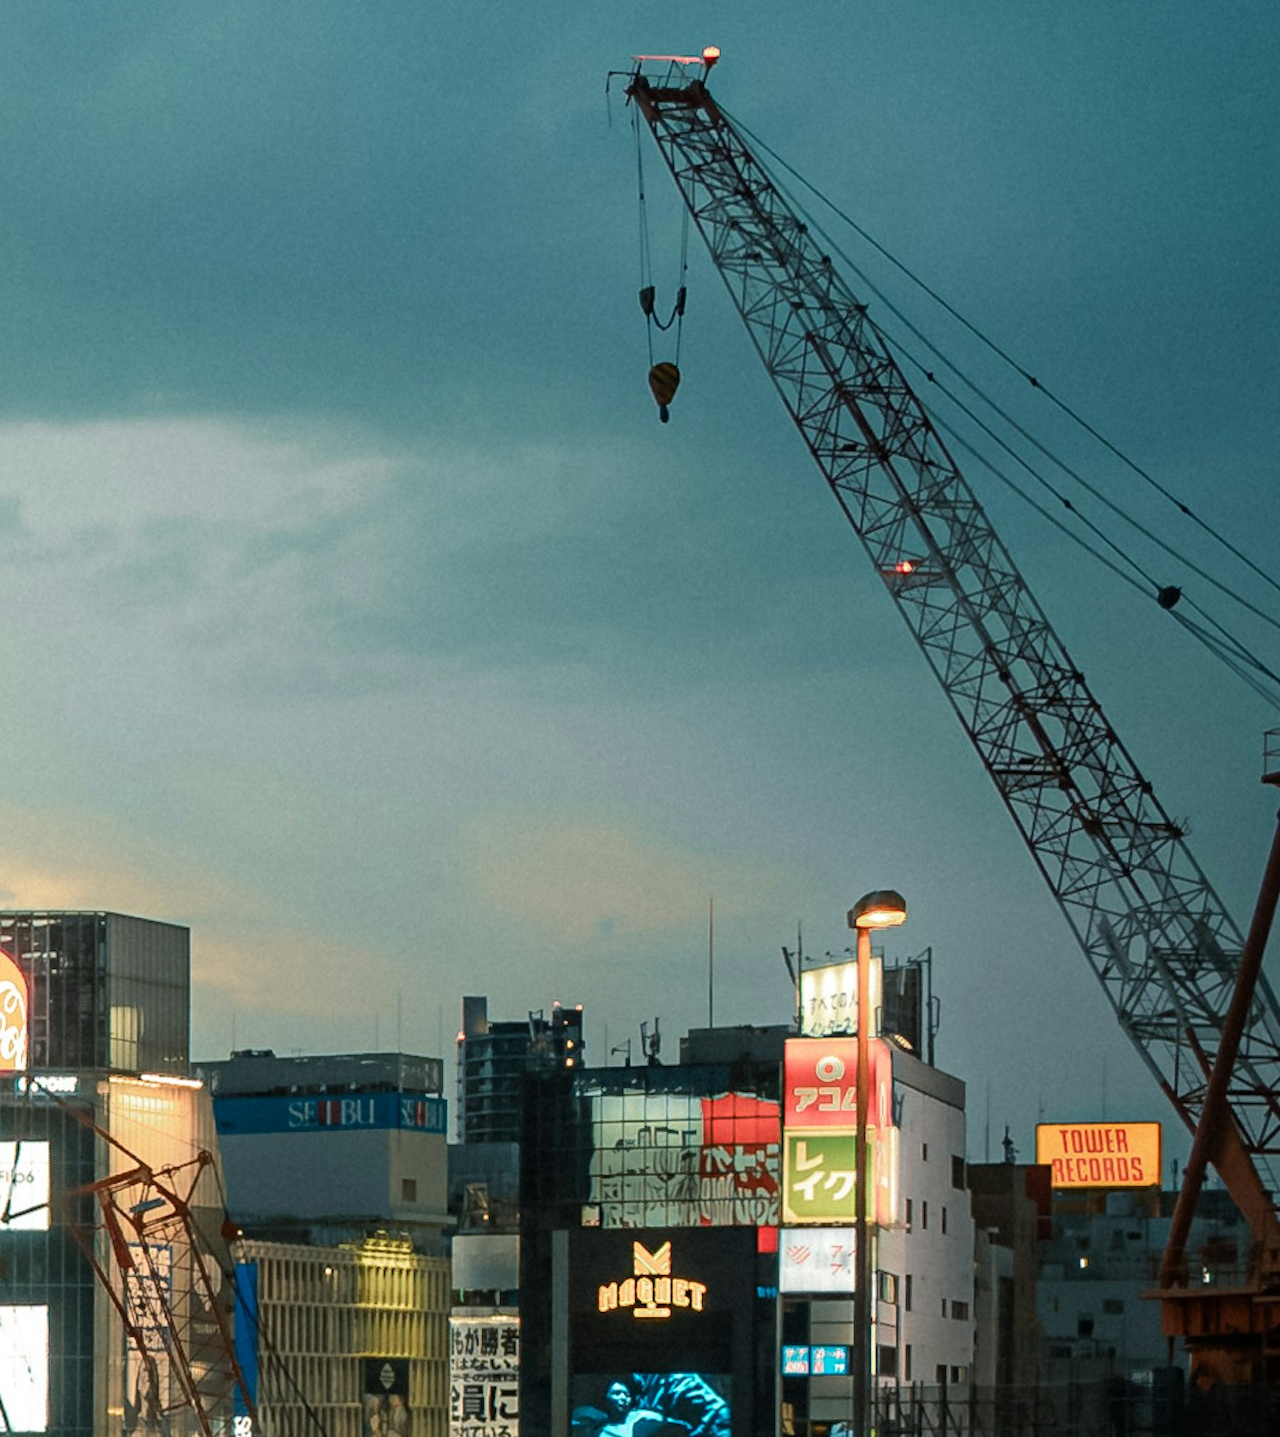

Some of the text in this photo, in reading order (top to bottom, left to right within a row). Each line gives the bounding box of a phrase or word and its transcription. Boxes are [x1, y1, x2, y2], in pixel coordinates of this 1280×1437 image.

[288, 1098, 375, 1128] SEIBU
[793, 1087, 857, 1113] アコム
[1059, 1129, 1129, 1154] TOWER
[1052, 1157, 1144, 1183] RECORDS
[599, 1277, 707, 1313] MAGNET
